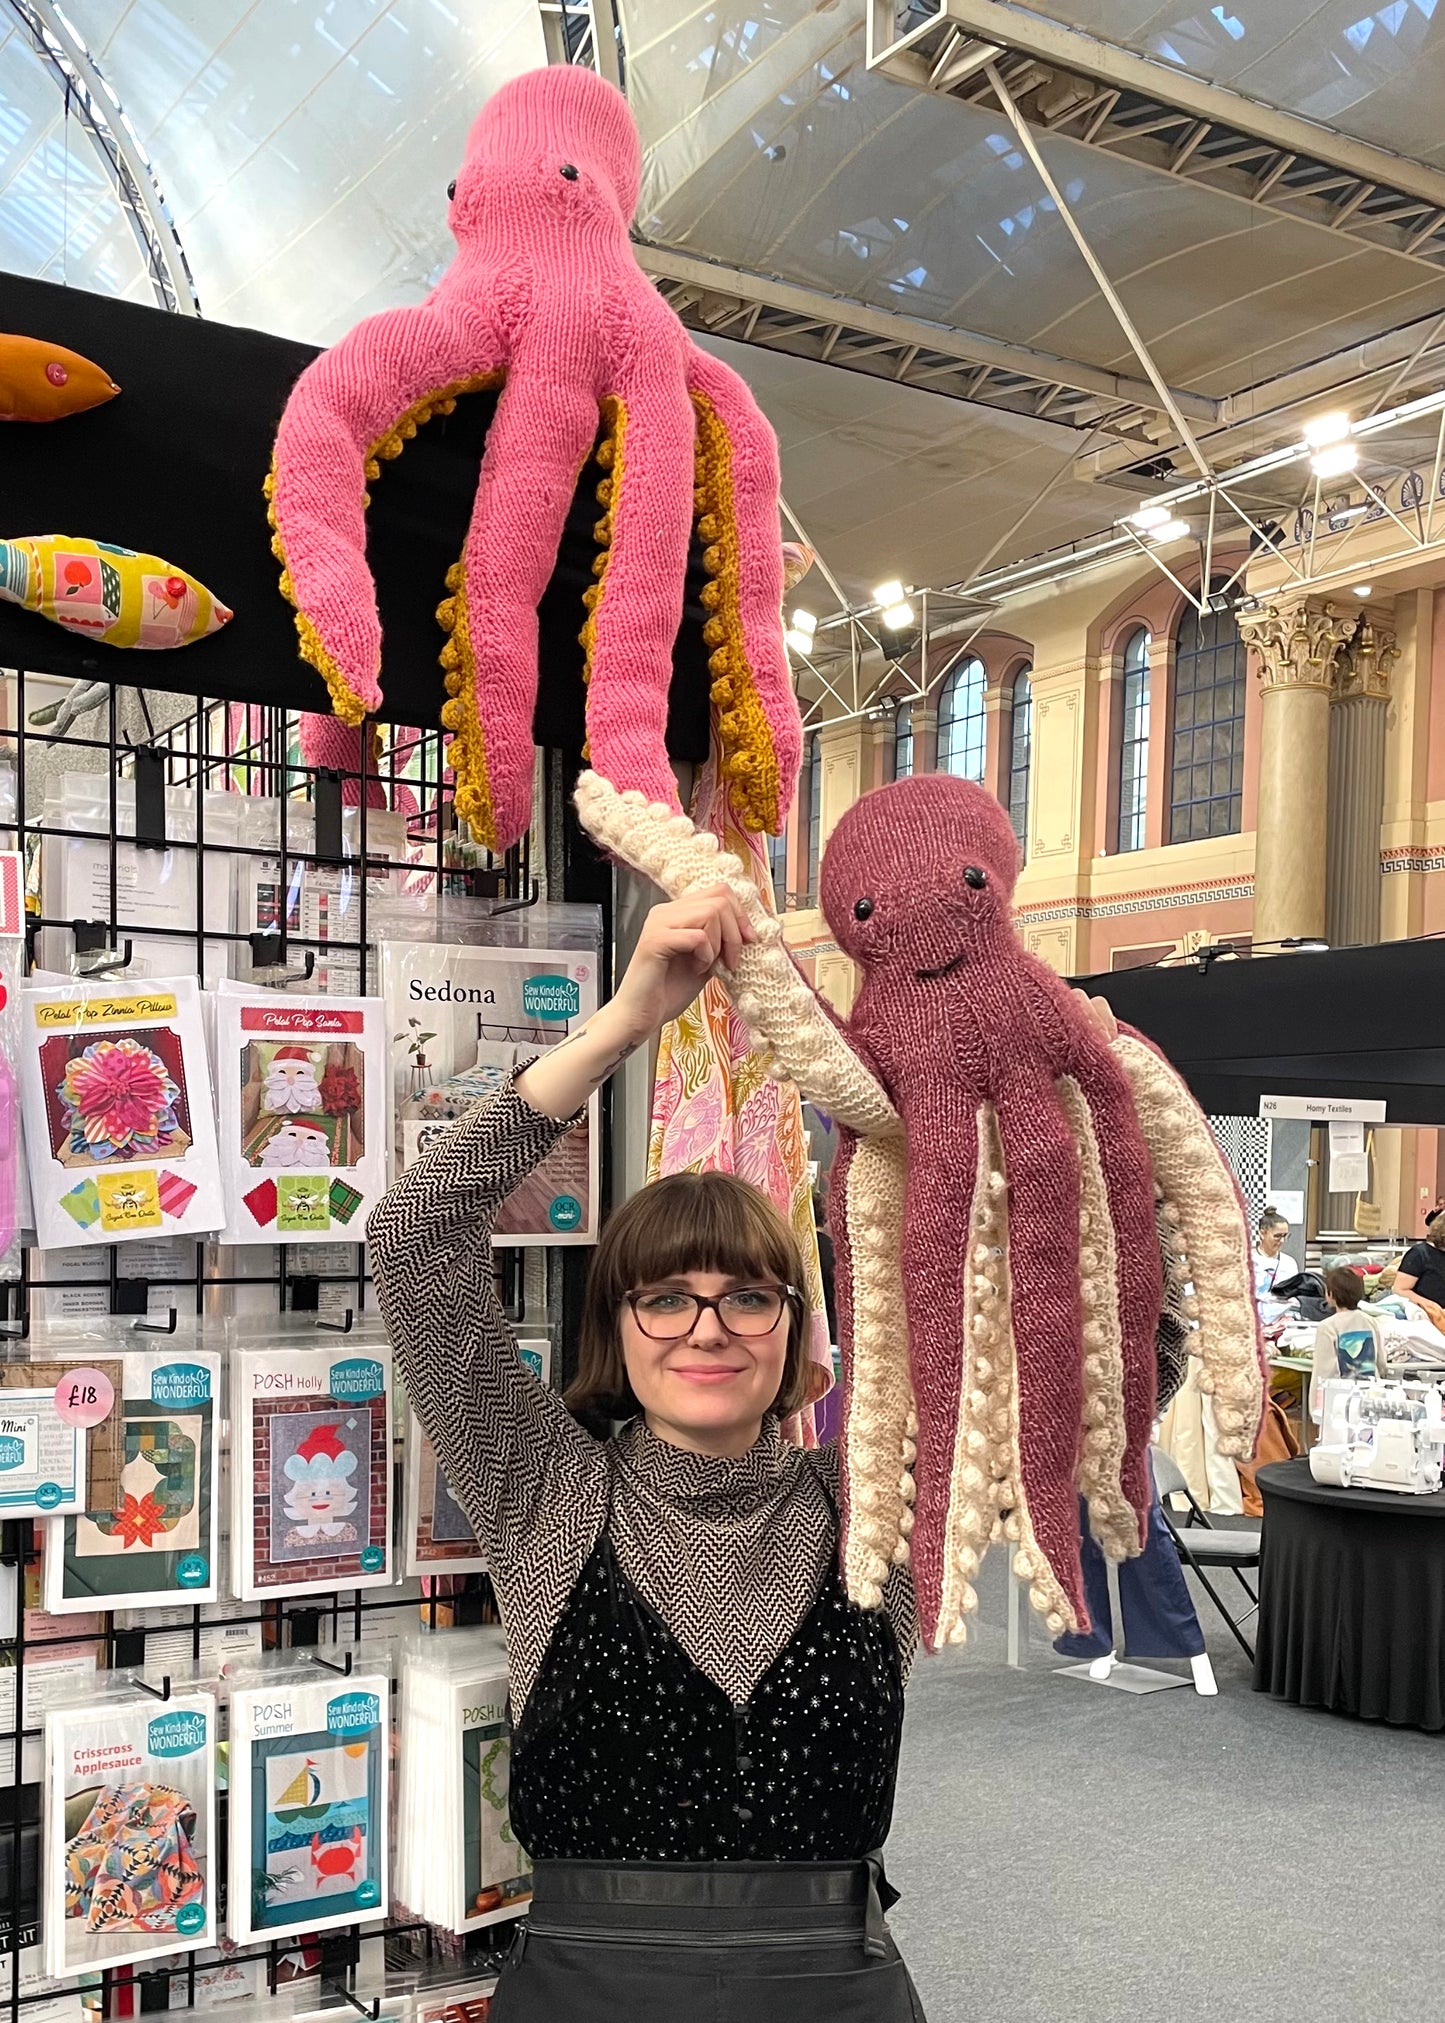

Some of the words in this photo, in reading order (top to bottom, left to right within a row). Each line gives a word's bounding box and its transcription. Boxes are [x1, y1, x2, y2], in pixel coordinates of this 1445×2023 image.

[409, 979, 497, 1004] Sedona
[524, 984, 539, 996] Sew
[539, 984, 555, 997] Kind
[39, 1007, 72, 1021] Petal
[101, 1003, 136, 1017] Zinnia
[136, 999, 173, 1015] Pillow
[524, 996, 579, 1012] WONDERFUL
[262, 1012, 291, 1026] Petal
[291, 1013, 314, 1027] Pop
[314, 1014, 343, 1028] Santa
[1263, 1101, 1277, 1110] N26
[1327, 1104, 1353, 1113] Textiles
[152, 1374, 168, 1385] Sew
[169, 1373, 184, 1384] Kind
[252, 1373, 293, 1390] POSH
[297, 1375, 323, 1391] Holly
[331, 1369, 346, 1380] Sew
[346, 1368, 360, 1379] Kind
[153, 1384, 209, 1399] WONDERFUL
[331, 1378, 383, 1394] WONDERFUL
[68, 1385, 98, 1408] £18
[1, 1419, 27, 1433] Mini
[252, 1702, 292, 1722] POSH
[328, 1704, 342, 1716] Sew
[342, 1702, 357, 1714] Kind
[462, 1704, 495, 1724] POSH
[328, 1710, 379, 1730] WONDERFUL
[149, 1725, 165, 1737] Sew
[165, 1722, 181, 1734] Kind
[254, 1722, 294, 1738] Summer
[149, 1730, 206, 1751] WONDERFUL
[73, 1743, 133, 1761] Crisscross
[73, 1755, 142, 1776] Applesauce
